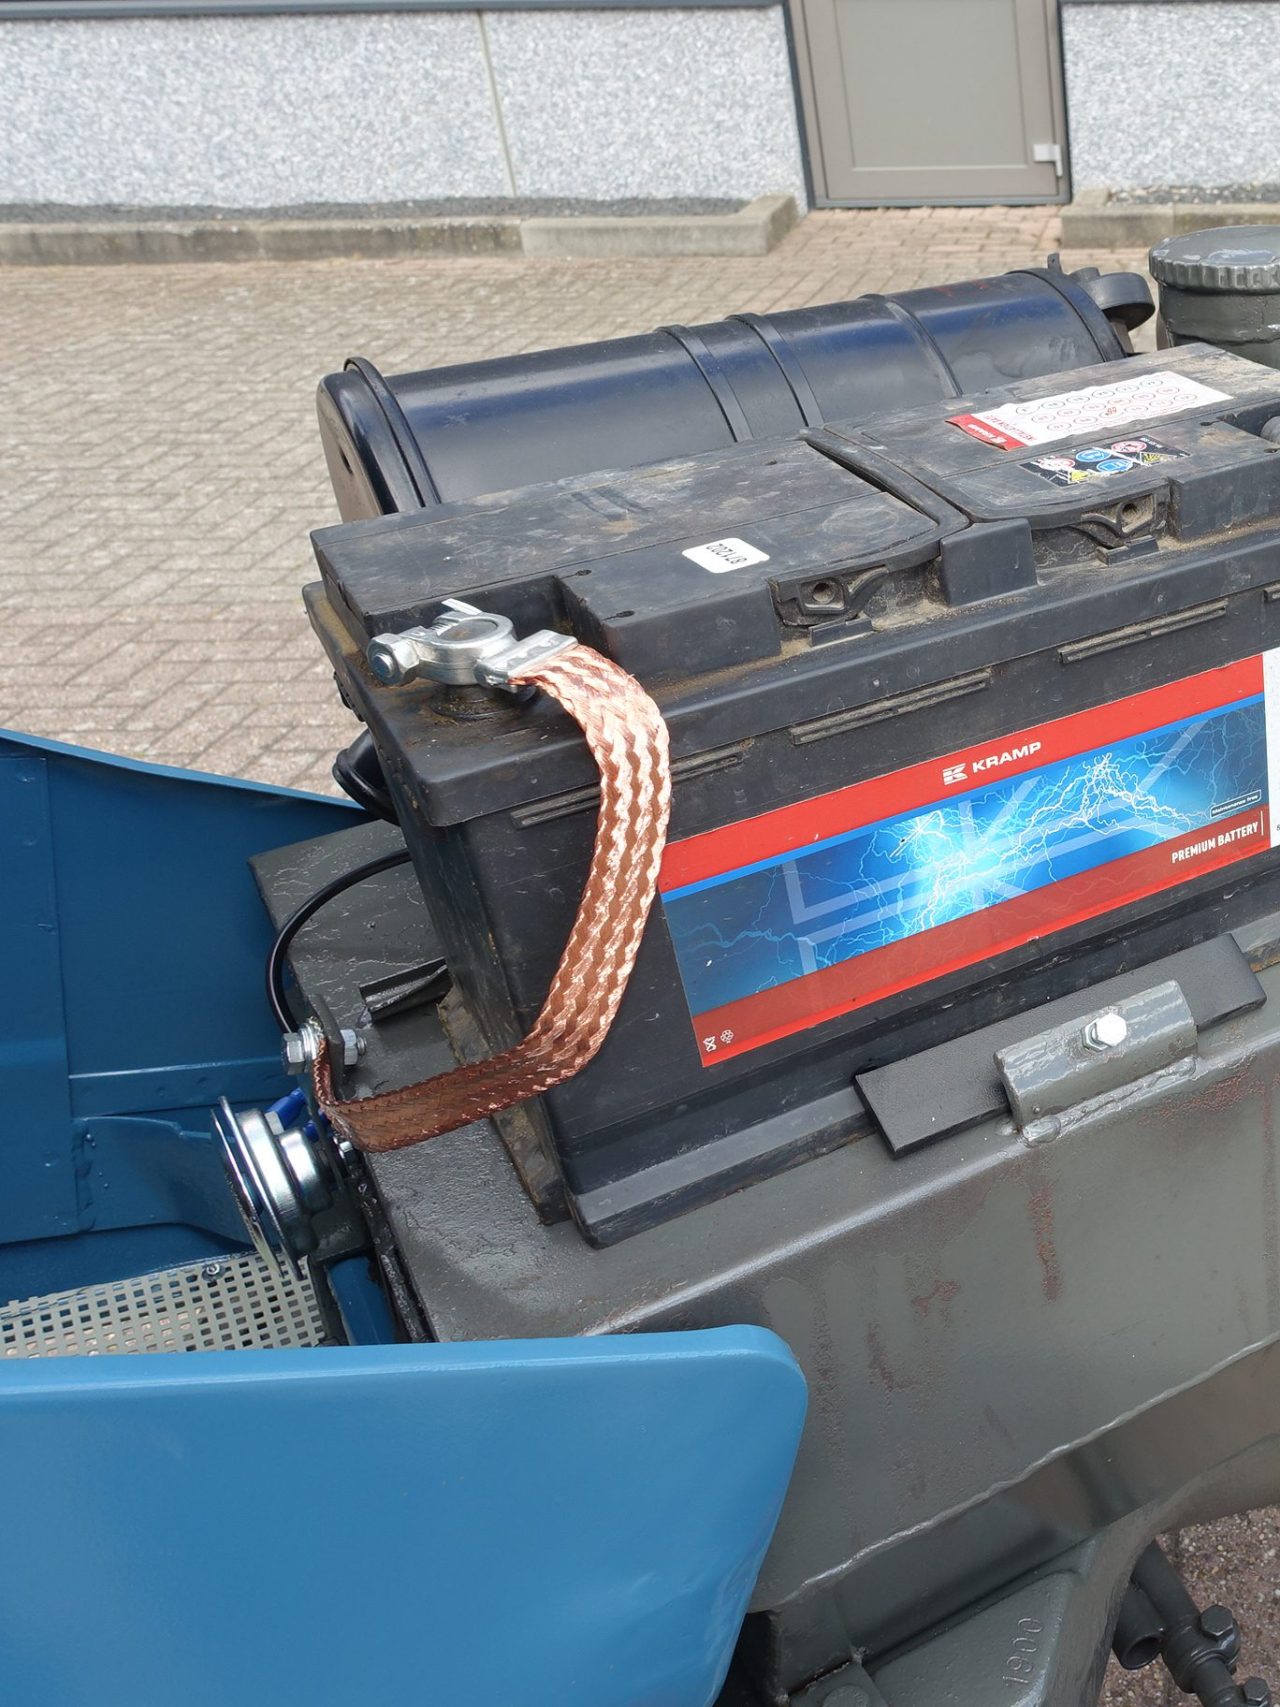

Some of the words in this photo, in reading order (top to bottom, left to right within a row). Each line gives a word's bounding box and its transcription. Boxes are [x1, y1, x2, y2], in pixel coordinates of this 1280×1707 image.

[972, 741, 1042, 773] KRAMP
[1171, 837, 1216, 864] PREMIUM
[1217, 821, 1259, 847] BATTERY
